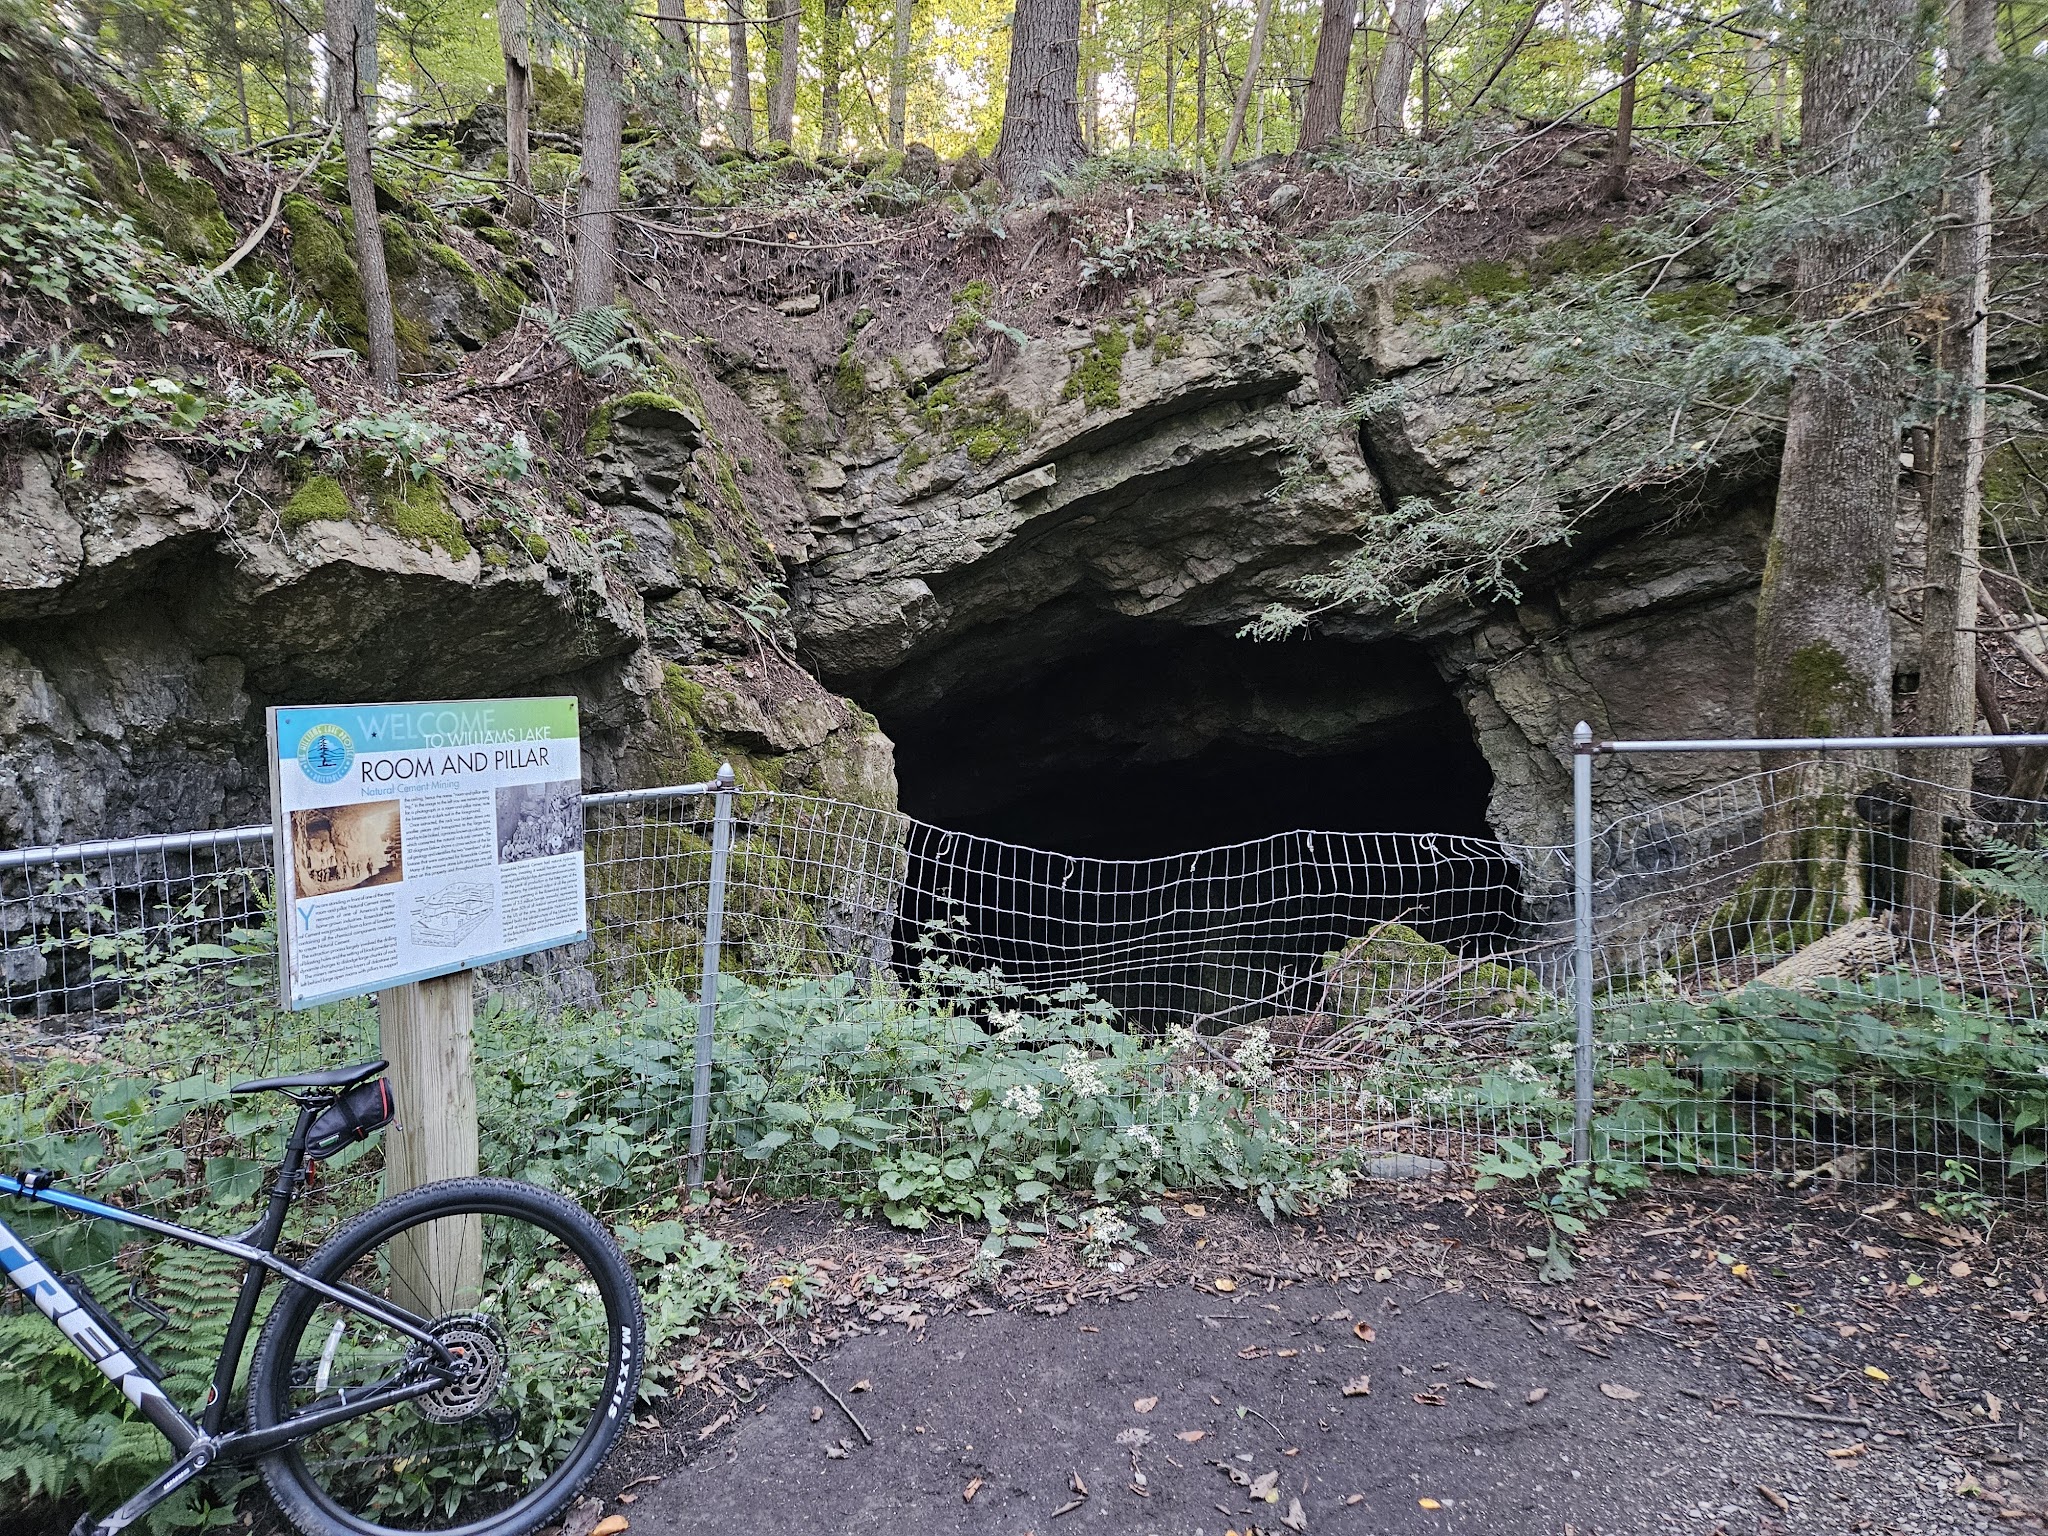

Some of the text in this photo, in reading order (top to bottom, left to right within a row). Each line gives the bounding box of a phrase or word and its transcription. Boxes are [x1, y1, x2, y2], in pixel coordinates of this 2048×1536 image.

[357, 709, 495, 743] WELCOME
[424, 726, 551, 749] TO WILLIAMS LAKE
[361, 747, 549, 783] ROOM AND PILLAR
[361, 778, 459, 797] Natural Cement Mining
[608, 1325, 631, 1420] MAXXIS
